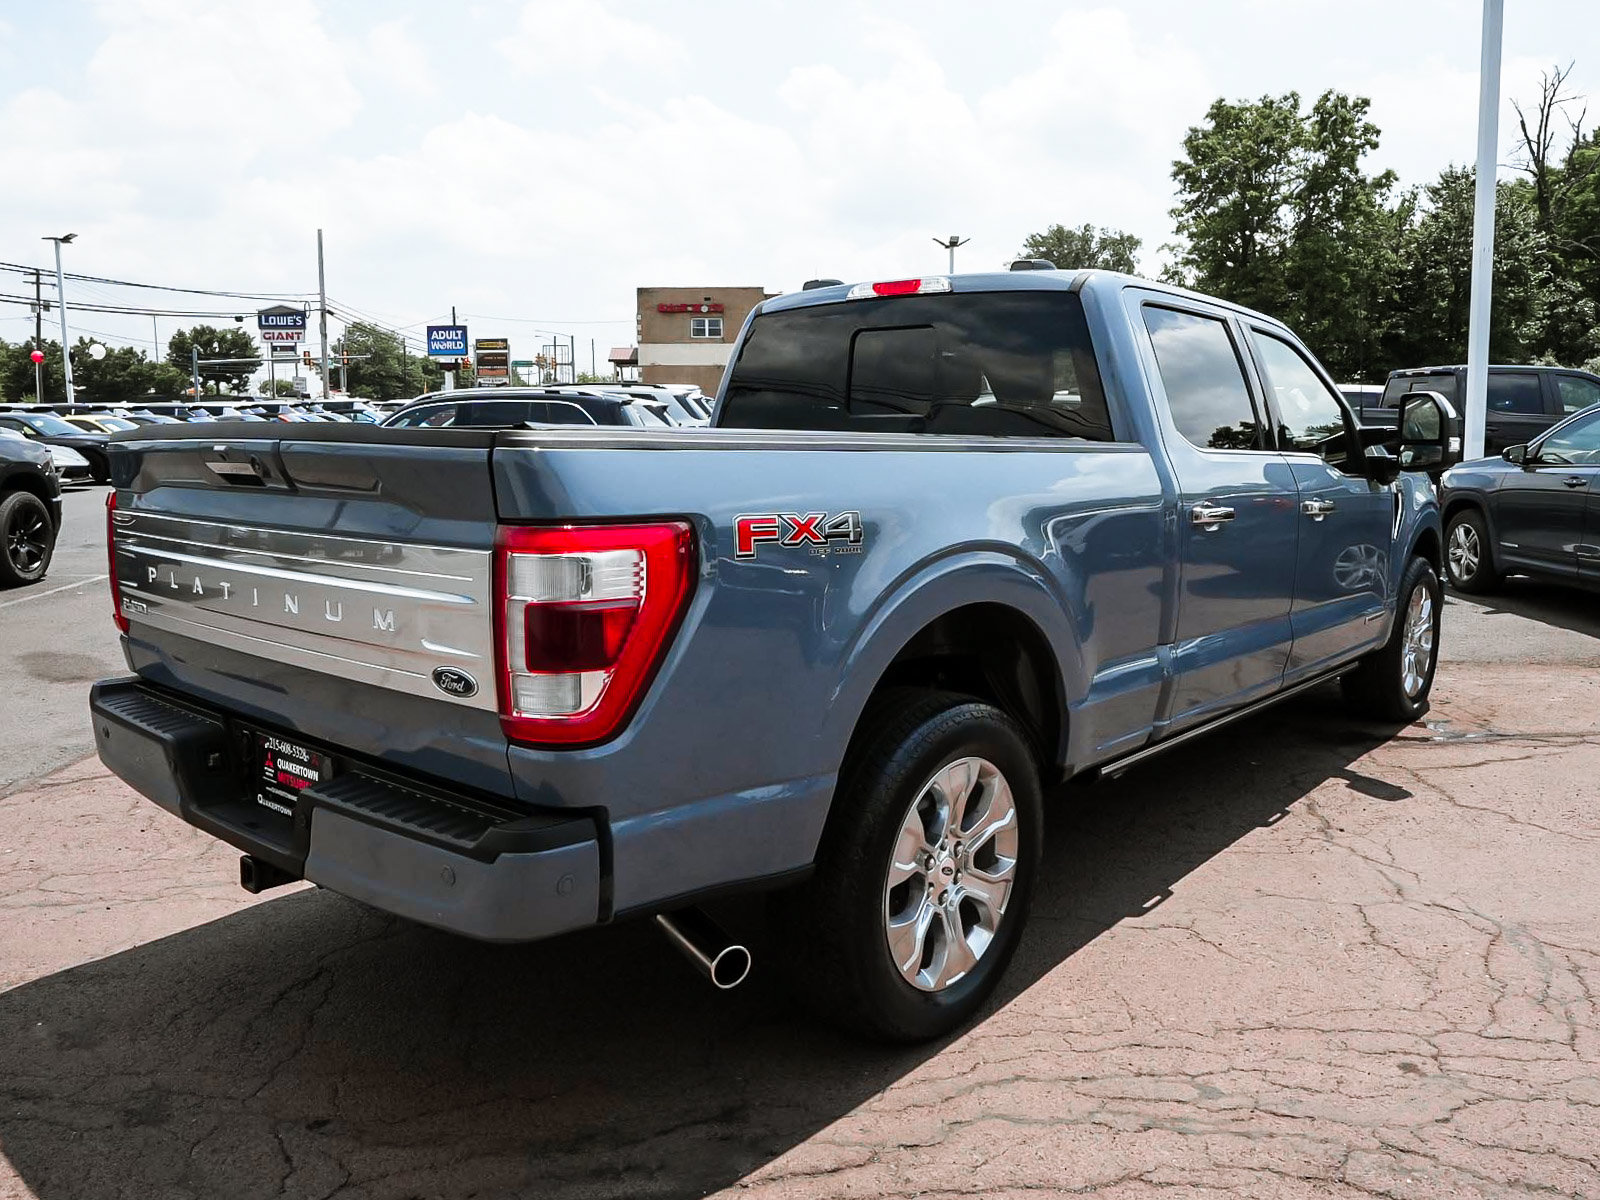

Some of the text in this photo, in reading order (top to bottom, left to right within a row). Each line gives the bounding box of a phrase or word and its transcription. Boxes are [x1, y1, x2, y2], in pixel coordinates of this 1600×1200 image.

[261, 314, 303, 326] LOWE'S
[262, 331, 303, 341] GIANT
[431, 330, 463, 340] ADULT
[431, 341, 464, 350] WORLD
[732, 510, 864, 561] FX4
[147, 565, 396, 632] PLATINUM
[440, 672, 466, 693] Ford
[277, 758, 319, 782] QUAKERTOWN
